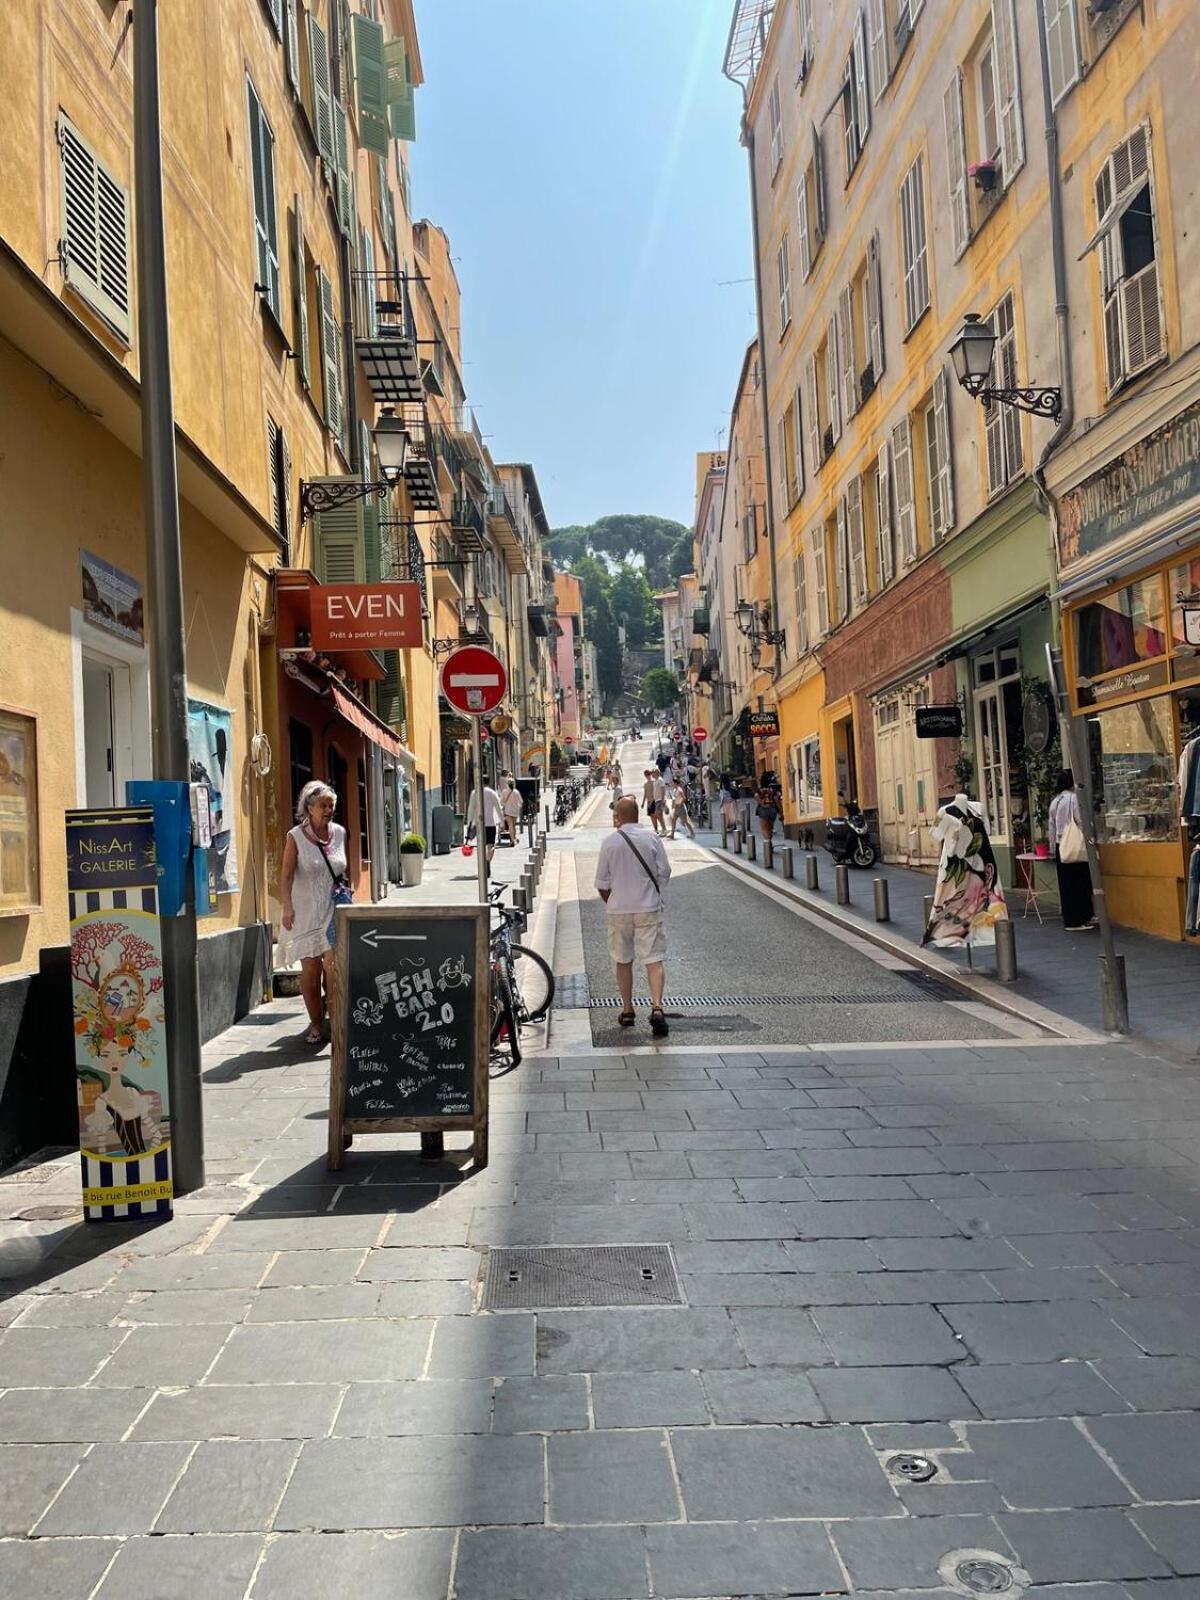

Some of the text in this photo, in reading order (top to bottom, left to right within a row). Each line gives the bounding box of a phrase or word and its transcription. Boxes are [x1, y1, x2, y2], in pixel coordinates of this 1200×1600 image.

[1172, 471, 1191, 495] 1907
[327, 594, 405, 619] EVEN
[329, 629, 405, 640] Prêt à porter Femme
[750, 723, 776, 734] SOCCA
[79, 837, 133, 855] NissArt
[80, 859, 137, 873] GALERIE
[375, 968, 435, 1004] FISH
[395, 990, 437, 1018] BAR
[415, 1002, 455, 1031] 2.0
[91, 1192, 104, 1201] bis
[159, 1185, 172, 1195] Bu
